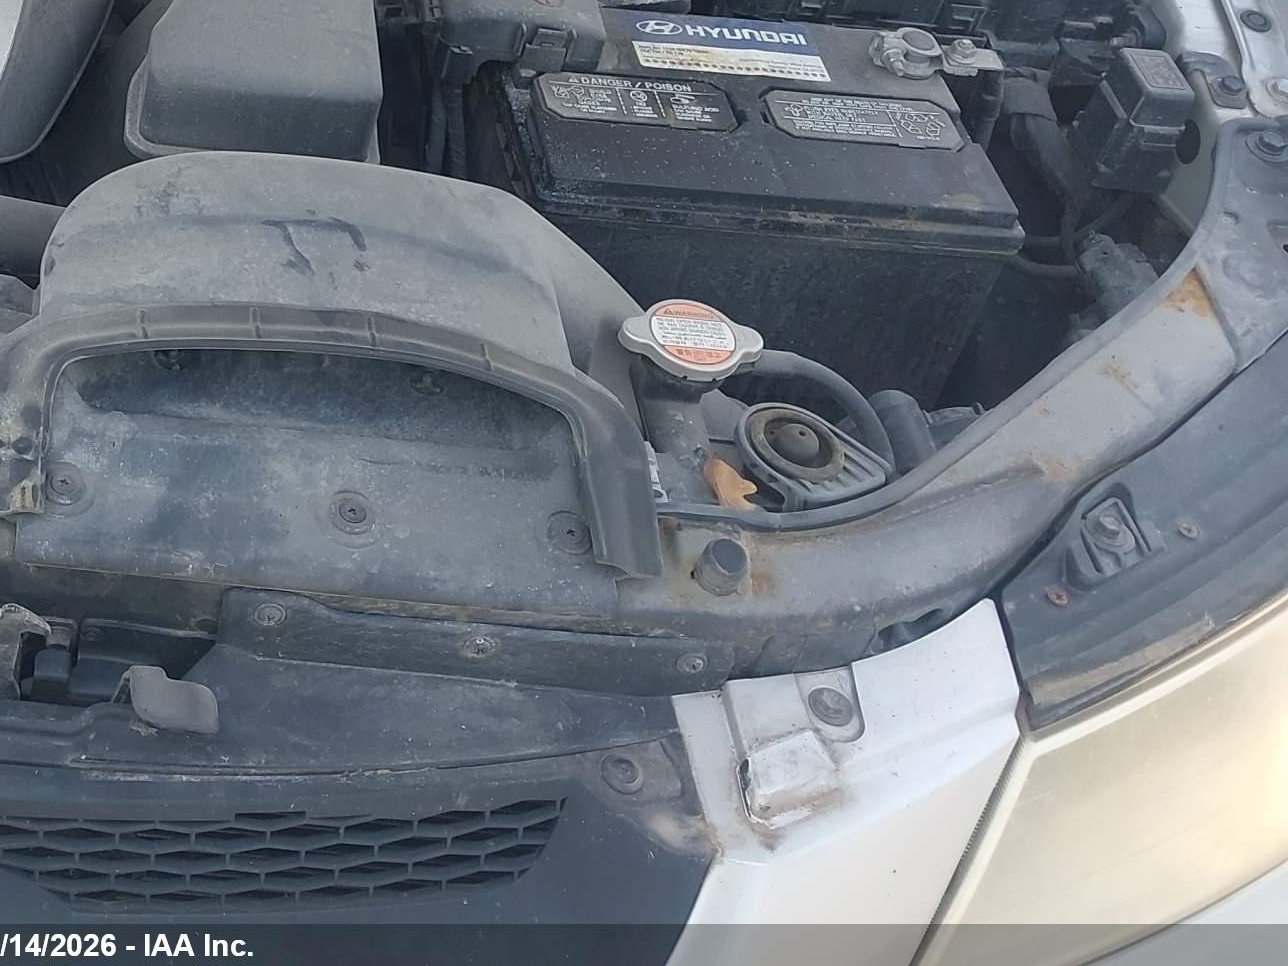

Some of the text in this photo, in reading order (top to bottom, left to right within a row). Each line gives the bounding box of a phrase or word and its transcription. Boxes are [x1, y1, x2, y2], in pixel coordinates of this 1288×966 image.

[683, 24, 808, 46] HYUNDAI
[580, 75, 632, 87] DANGER
[645, 80, 692, 92] POISON
